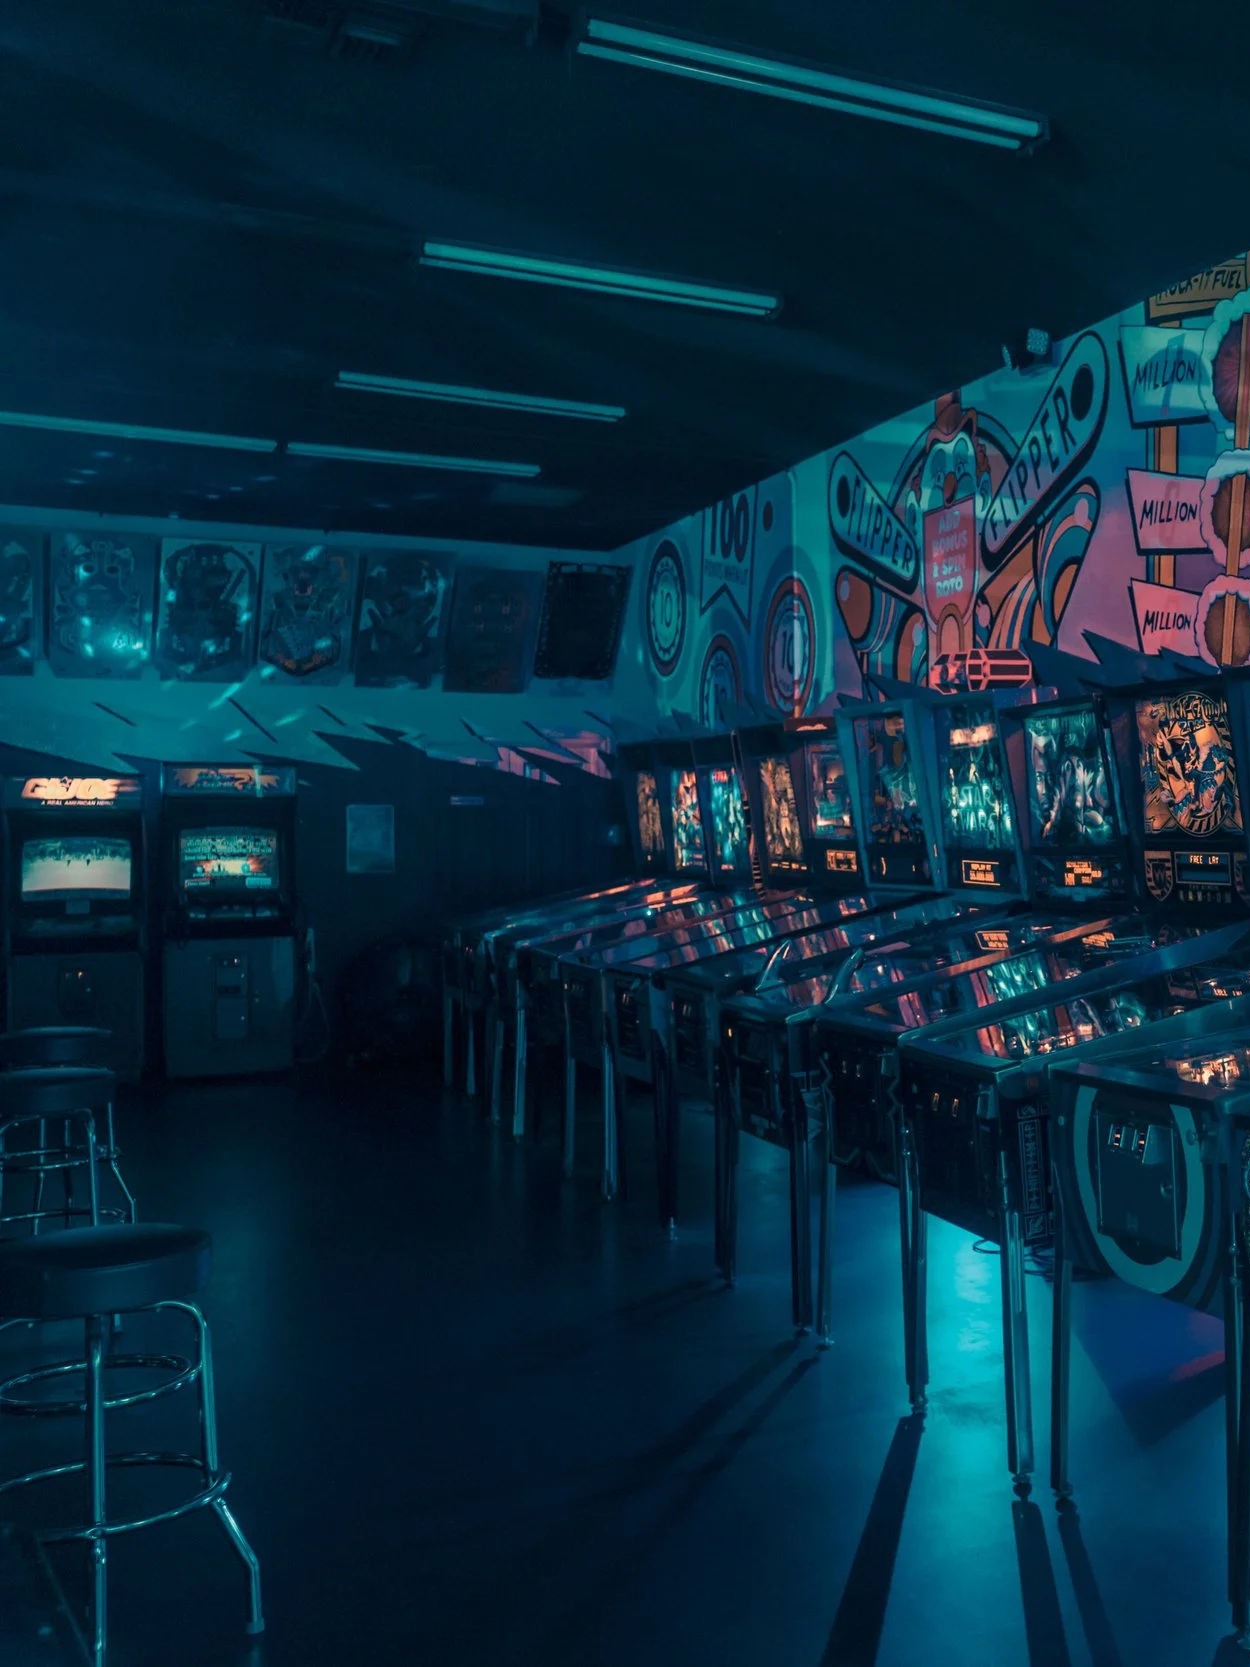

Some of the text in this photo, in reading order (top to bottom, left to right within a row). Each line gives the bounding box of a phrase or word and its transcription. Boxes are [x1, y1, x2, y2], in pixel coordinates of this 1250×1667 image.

[1211, 268, 1242, 290] FUEL
[1132, 357, 1196, 395] MILLION
[989, 385, 1078, 542] FLIPPER
[847, 474, 914, 573] FLIPPER
[1139, 499, 1198, 530] MILLION
[1142, 609, 1192, 636] MILLION
[958, 783, 995, 808] STAR
[1189, 855, 1203, 864] FREE
